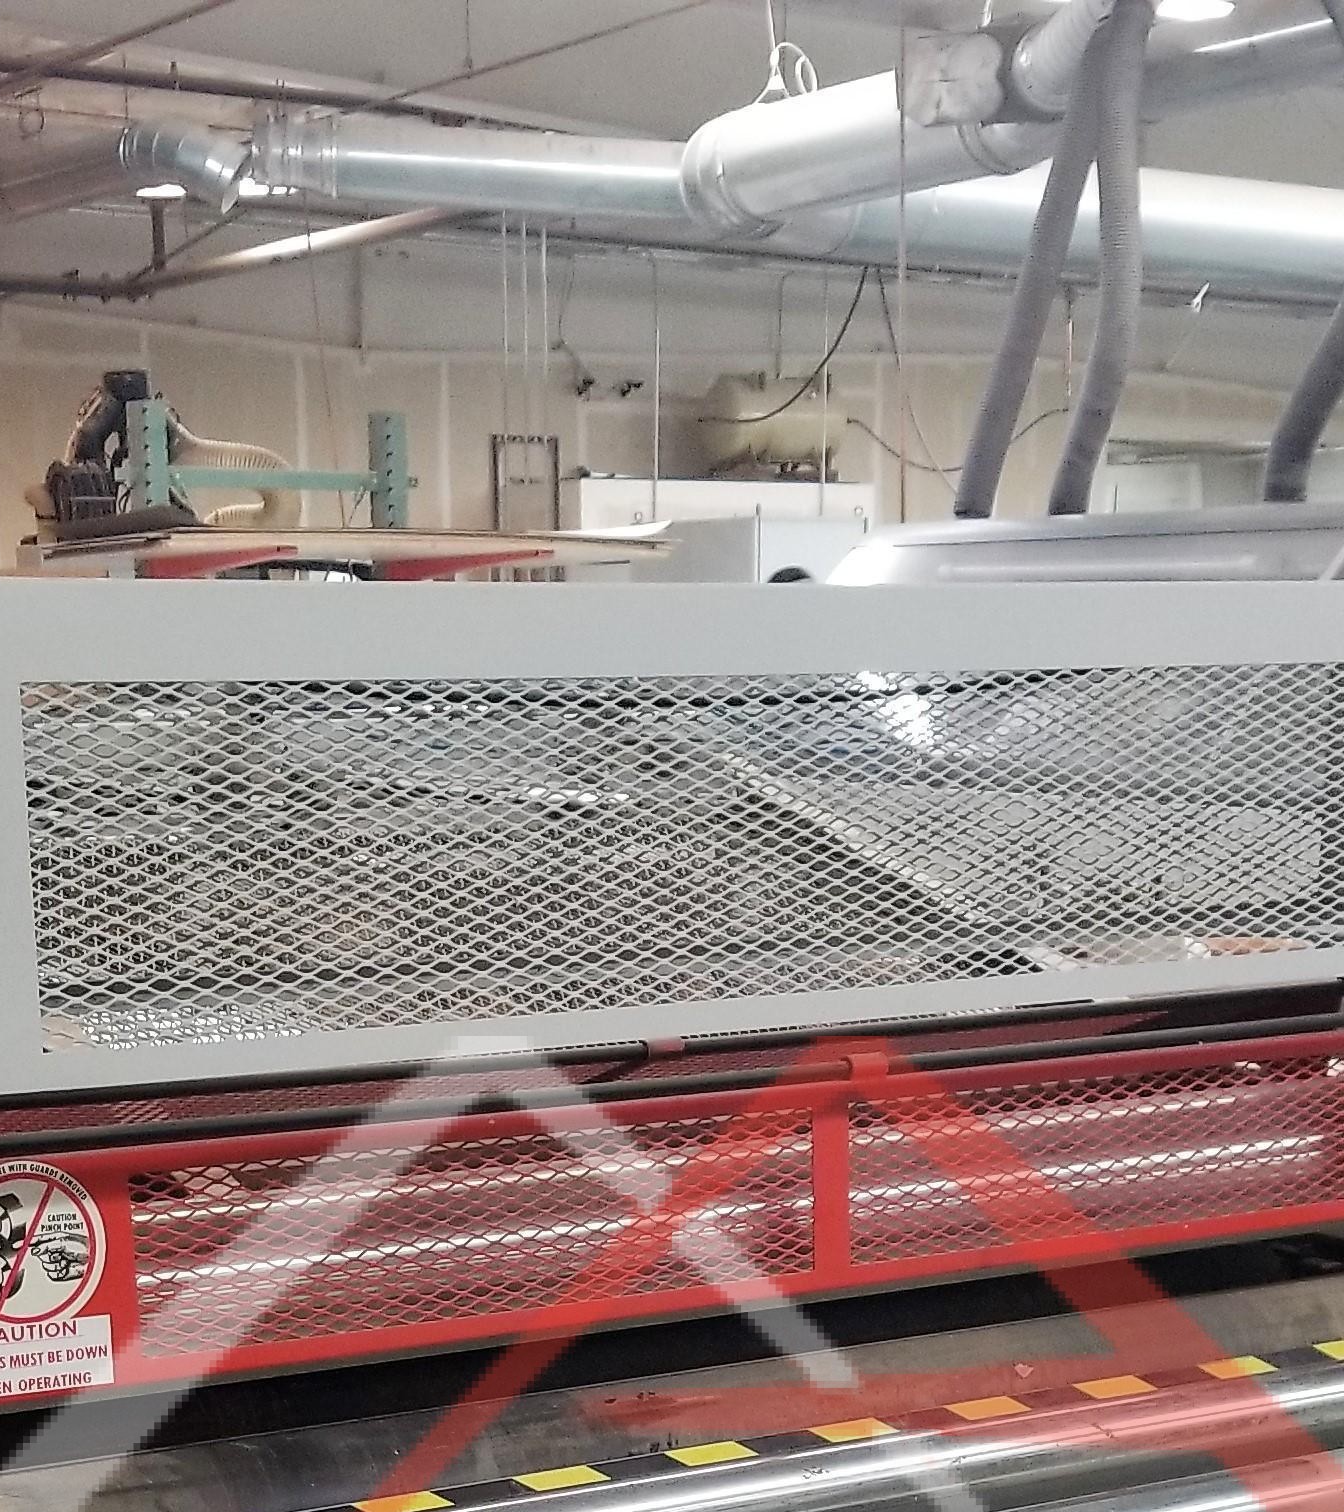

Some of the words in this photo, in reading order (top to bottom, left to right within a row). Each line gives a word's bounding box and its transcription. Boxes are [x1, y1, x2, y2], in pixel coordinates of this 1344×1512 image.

[8, 1163, 28, 1173] WITH
[29, 1163, 59, 1178] GUARDS
[59, 1173, 88, 1201] REMOVED
[40, 1223, 62, 1233] PINCH
[63, 1222, 84, 1231] POINT
[47, 1213, 77, 1223] CAUTION
[9, 1352, 44, 1369] MUST
[47, 1350, 63, 1364] BE
[66, 1344, 108, 1362] DOWN
[18, 1371, 93, 1392] OPERATING
